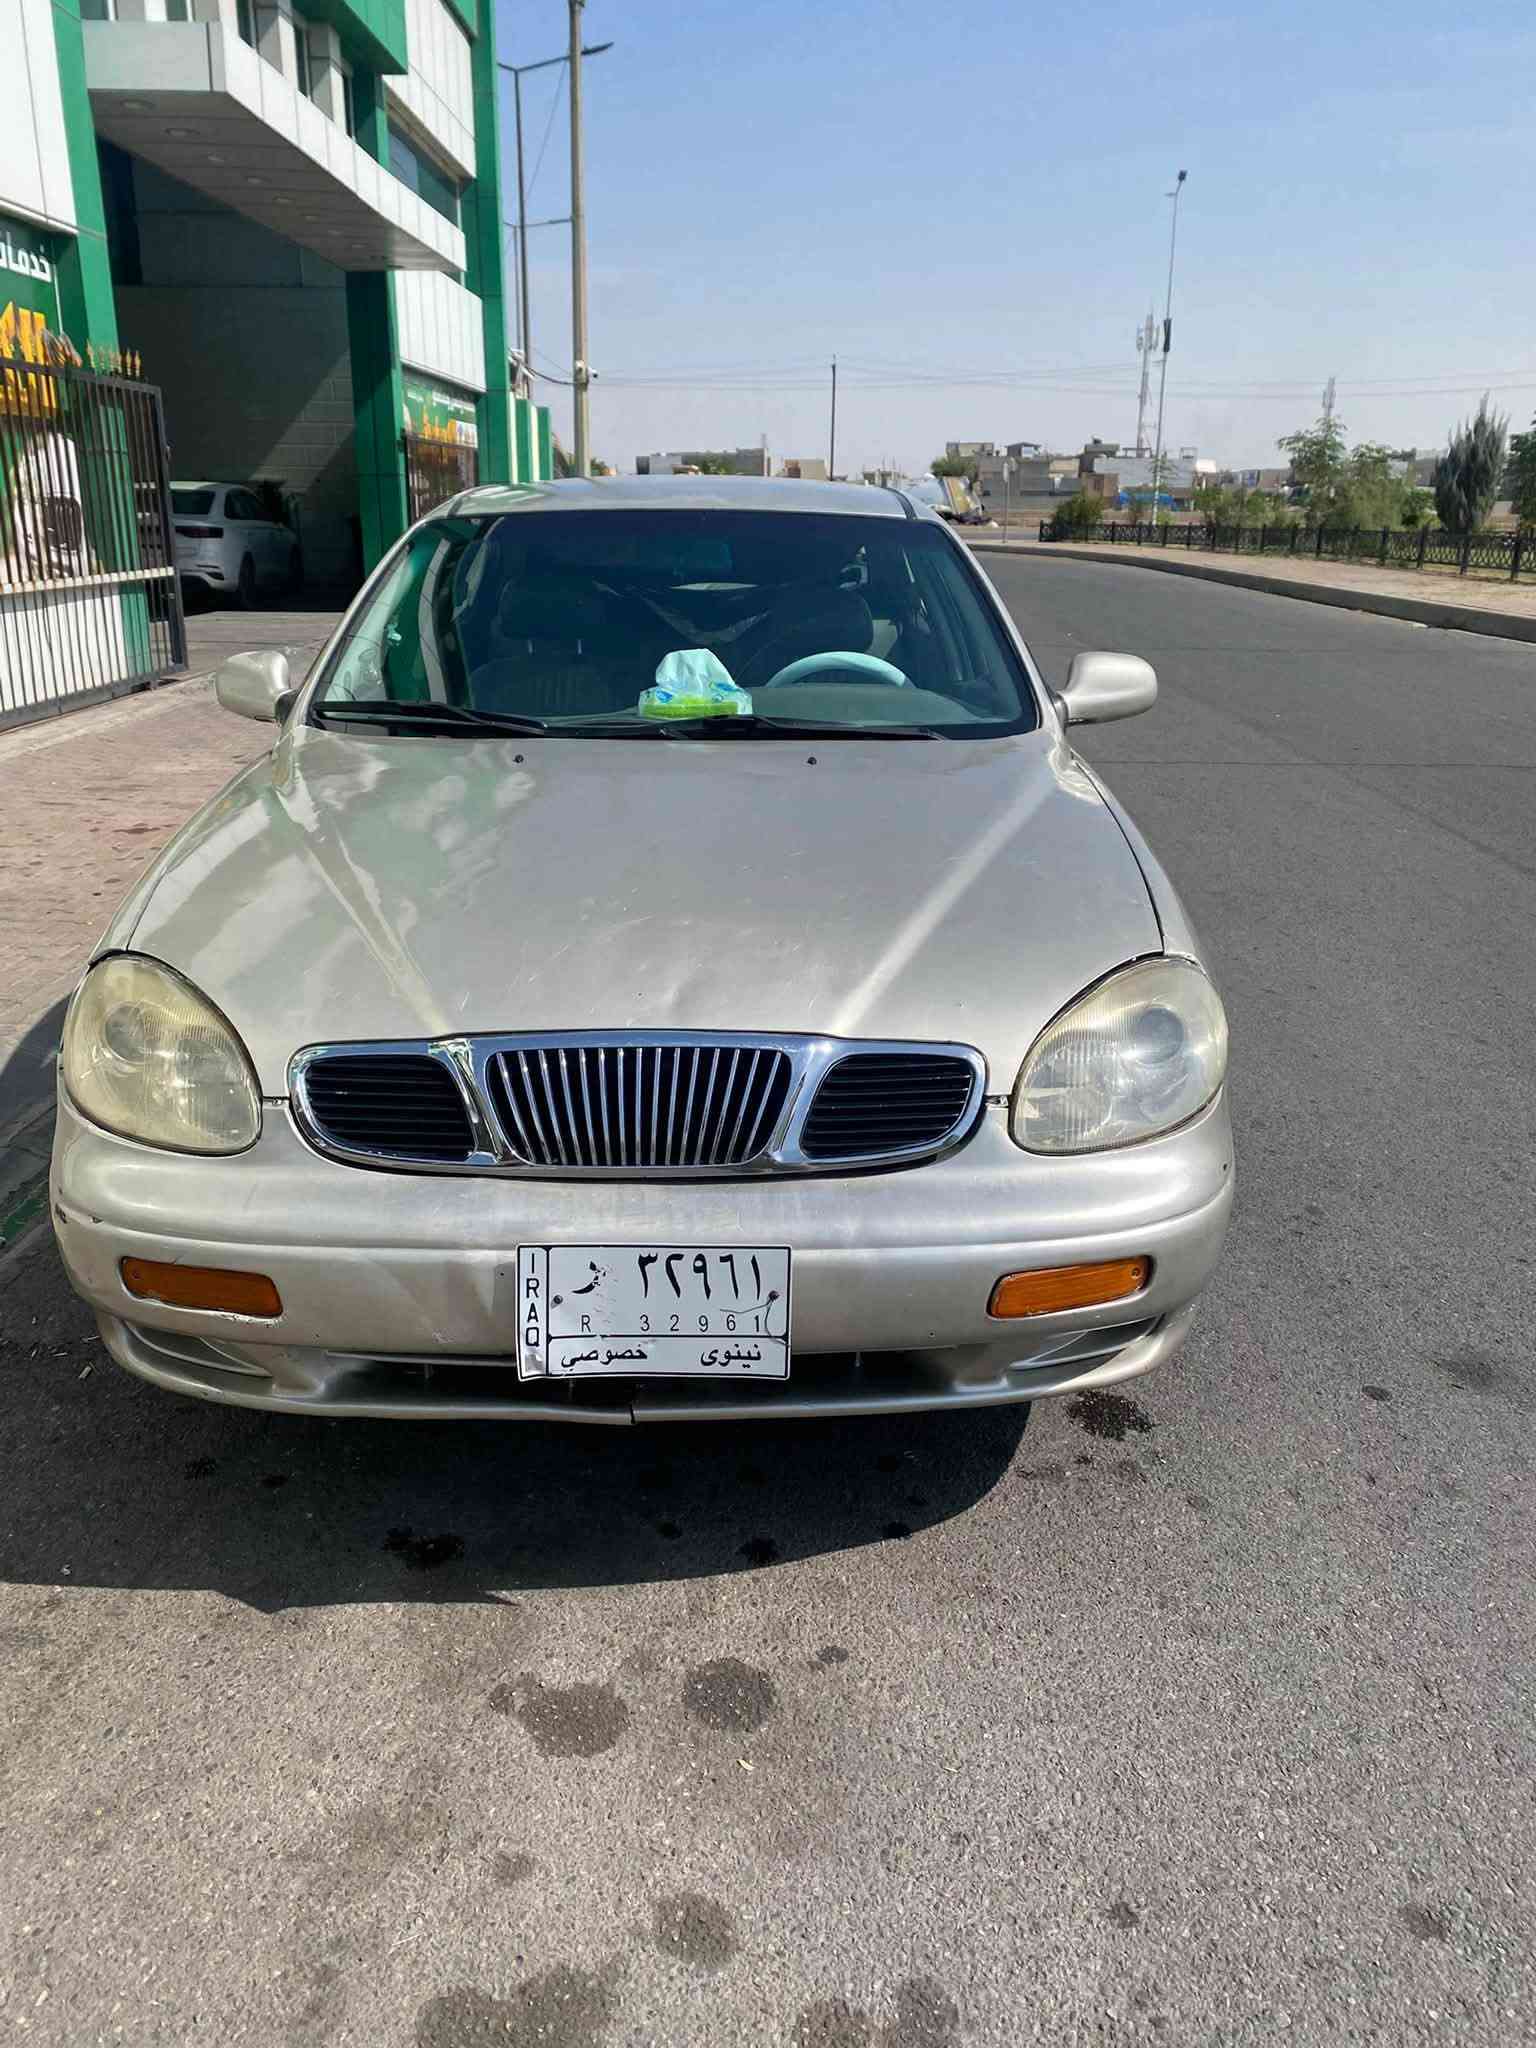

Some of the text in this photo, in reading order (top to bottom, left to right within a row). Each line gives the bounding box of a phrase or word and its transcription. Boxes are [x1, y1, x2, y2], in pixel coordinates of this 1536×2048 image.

[0, 231, 52, 283] خدما
[525, 1253, 540, 1347] IRAQ
[638, 1252, 761, 1300] ٣٢٩٦١
[581, 1313, 760, 1333] R 32961
[561, 1343, 762, 1372] خصوصي نينوى
